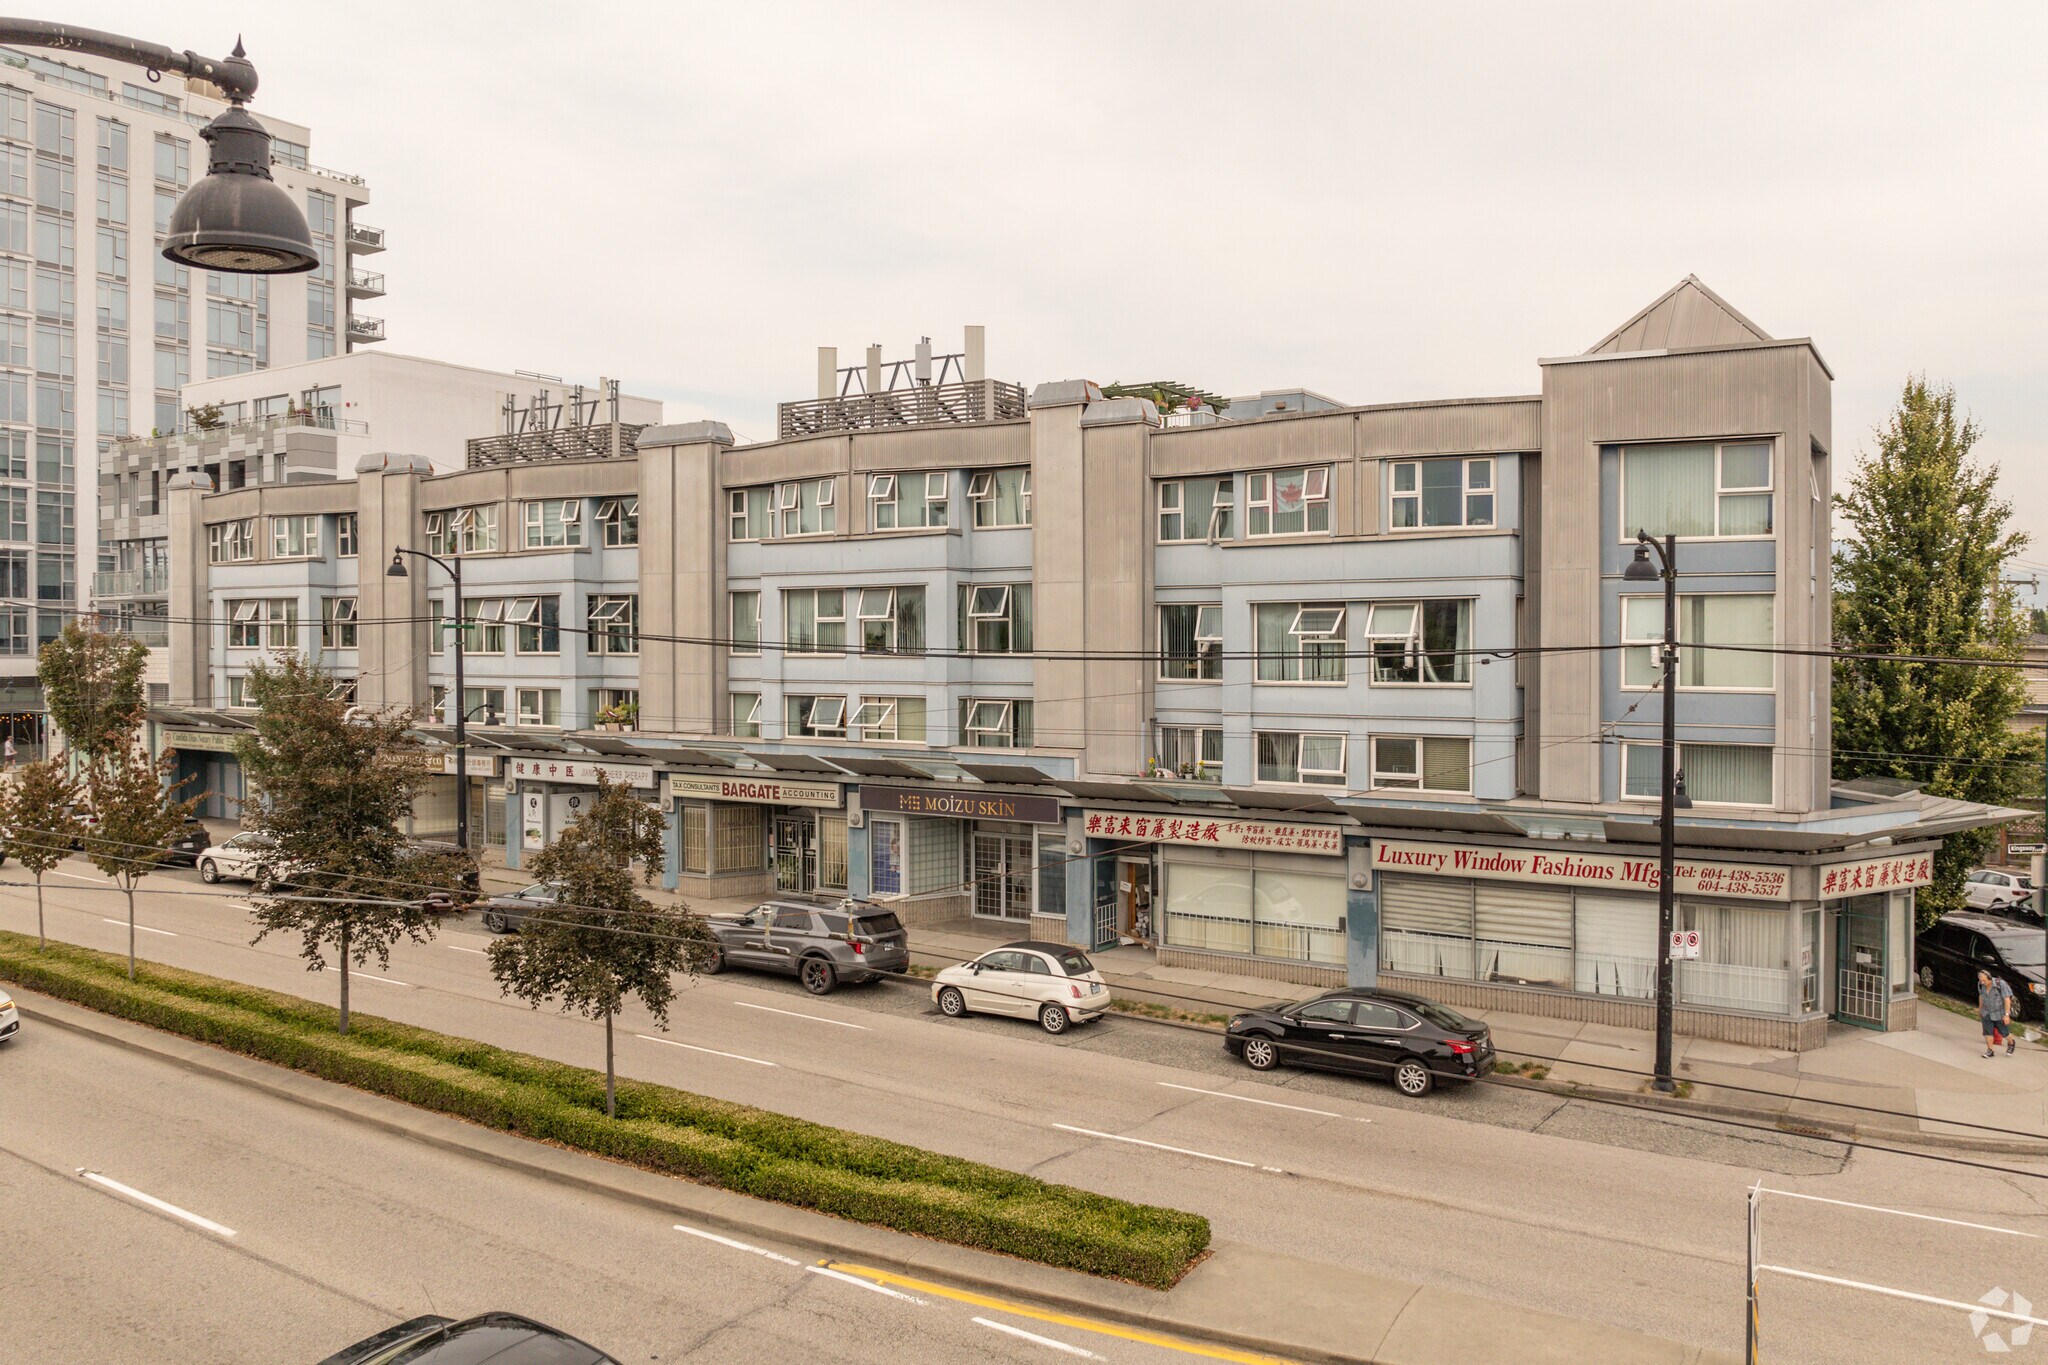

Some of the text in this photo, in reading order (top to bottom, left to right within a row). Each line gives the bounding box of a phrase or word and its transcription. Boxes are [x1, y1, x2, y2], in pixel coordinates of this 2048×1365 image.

[515, 761, 575, 777] 健康中医
[607, 769, 623, 780] HERB
[624, 770, 649, 781] THERAPY
[672, 781, 720, 792] TAX CONSULTANTS
[721, 782, 781, 800] BARGATE
[782, 789, 836, 800] ACCOUNTING
[2010, 845, 2036, 853] Kingsway
[1377, 844, 1448, 872] Luxury
[1453, 850, 1527, 873] Window
[1530, 855, 1614, 880] Fashions
[1673, 865, 1785, 884] Tel: 604-438-5536
[1697, 879, 1782, 896] 604-438-5537
